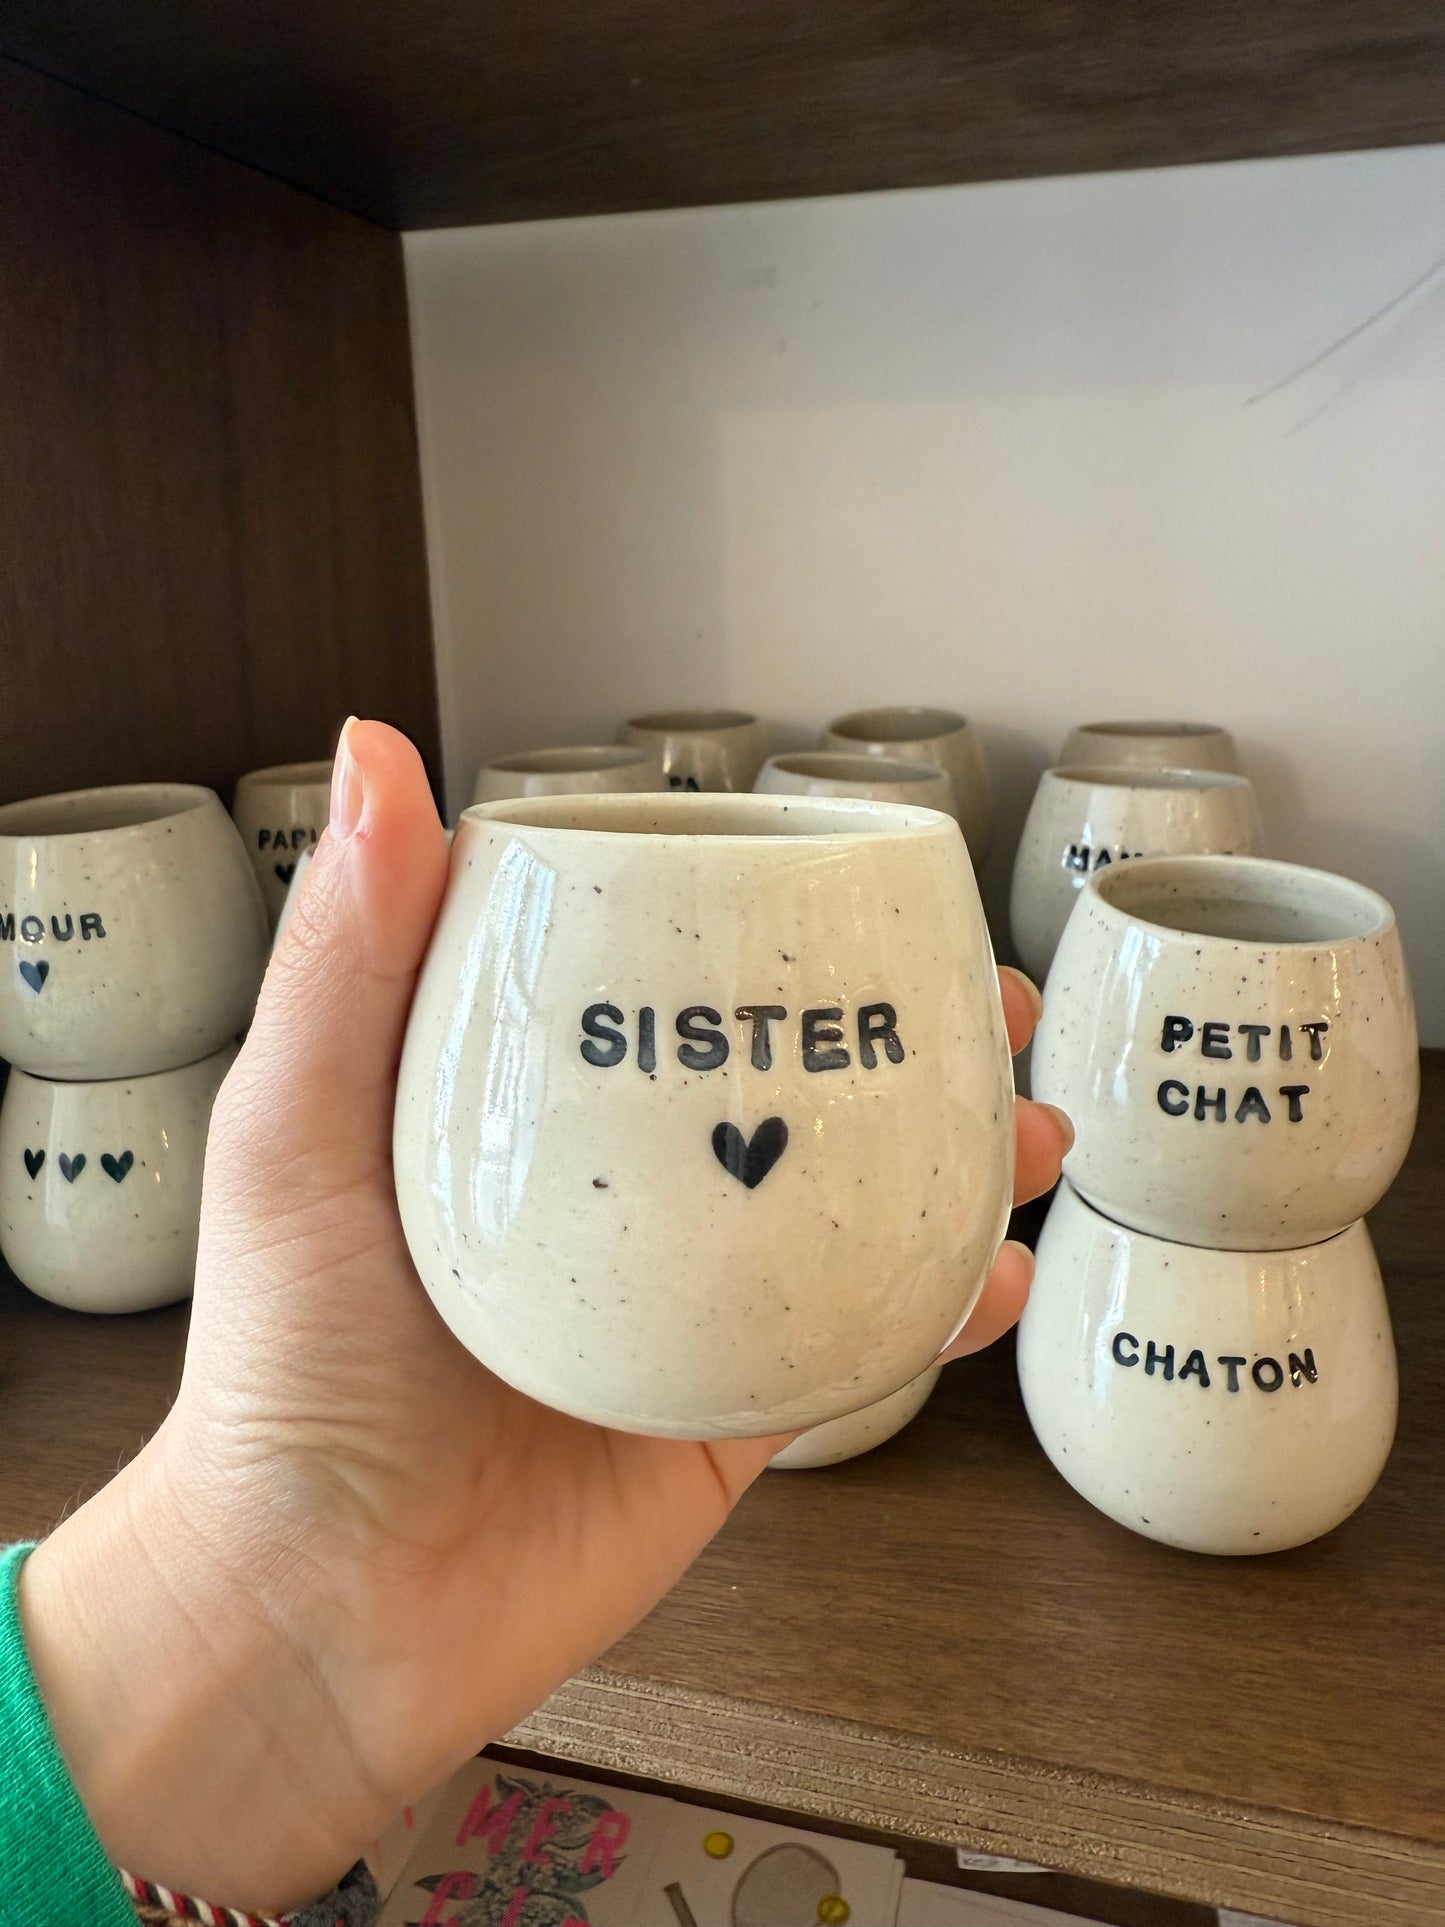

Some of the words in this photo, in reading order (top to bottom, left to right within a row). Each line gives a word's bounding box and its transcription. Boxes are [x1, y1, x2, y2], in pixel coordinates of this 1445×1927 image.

[580, 1002, 905, 1073] SISTER
[1161, 1015, 1329, 1063] PETIT
[1157, 1079, 1310, 1123] CHAT
[1112, 1331, 1319, 1393] CHATON
[455, 1784, 632, 1878] MER
